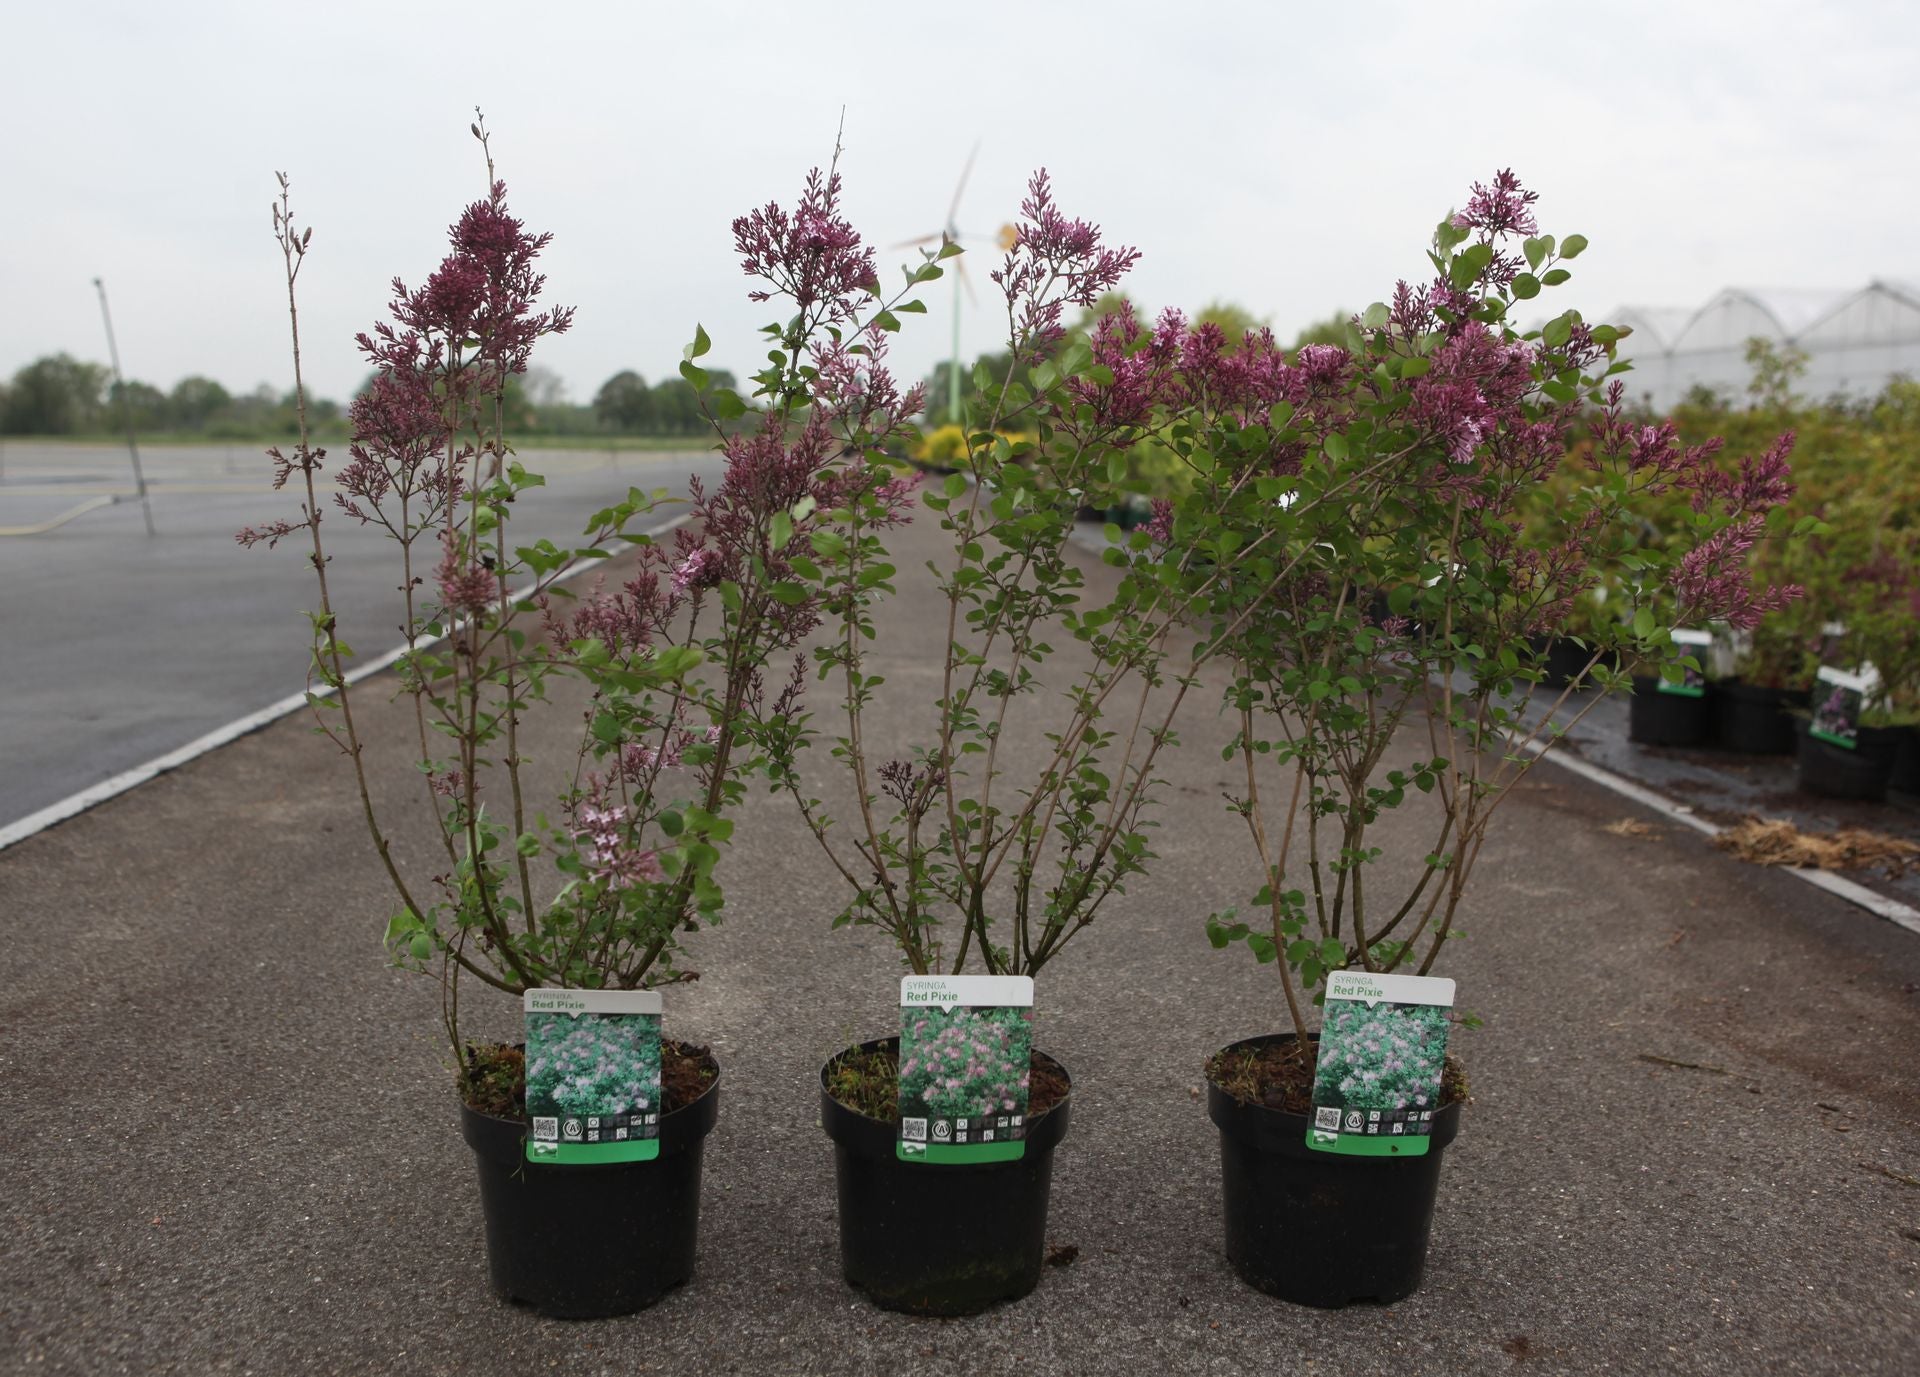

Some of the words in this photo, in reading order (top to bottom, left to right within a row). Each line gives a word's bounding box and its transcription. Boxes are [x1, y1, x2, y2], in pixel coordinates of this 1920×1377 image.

[1335, 975, 1373, 985] SYRINGA
[906, 981, 947, 990] SYRINGA
[1333, 985, 1354, 996] Red
[1357, 986, 1383, 997] Pixie
[531, 992, 573, 1000] SYRINGA
[906, 991, 928, 1001] Red
[931, 991, 958, 1001] Pixie
[532, 1000, 554, 1009] Red
[557, 1000, 585, 1009] Pixie
